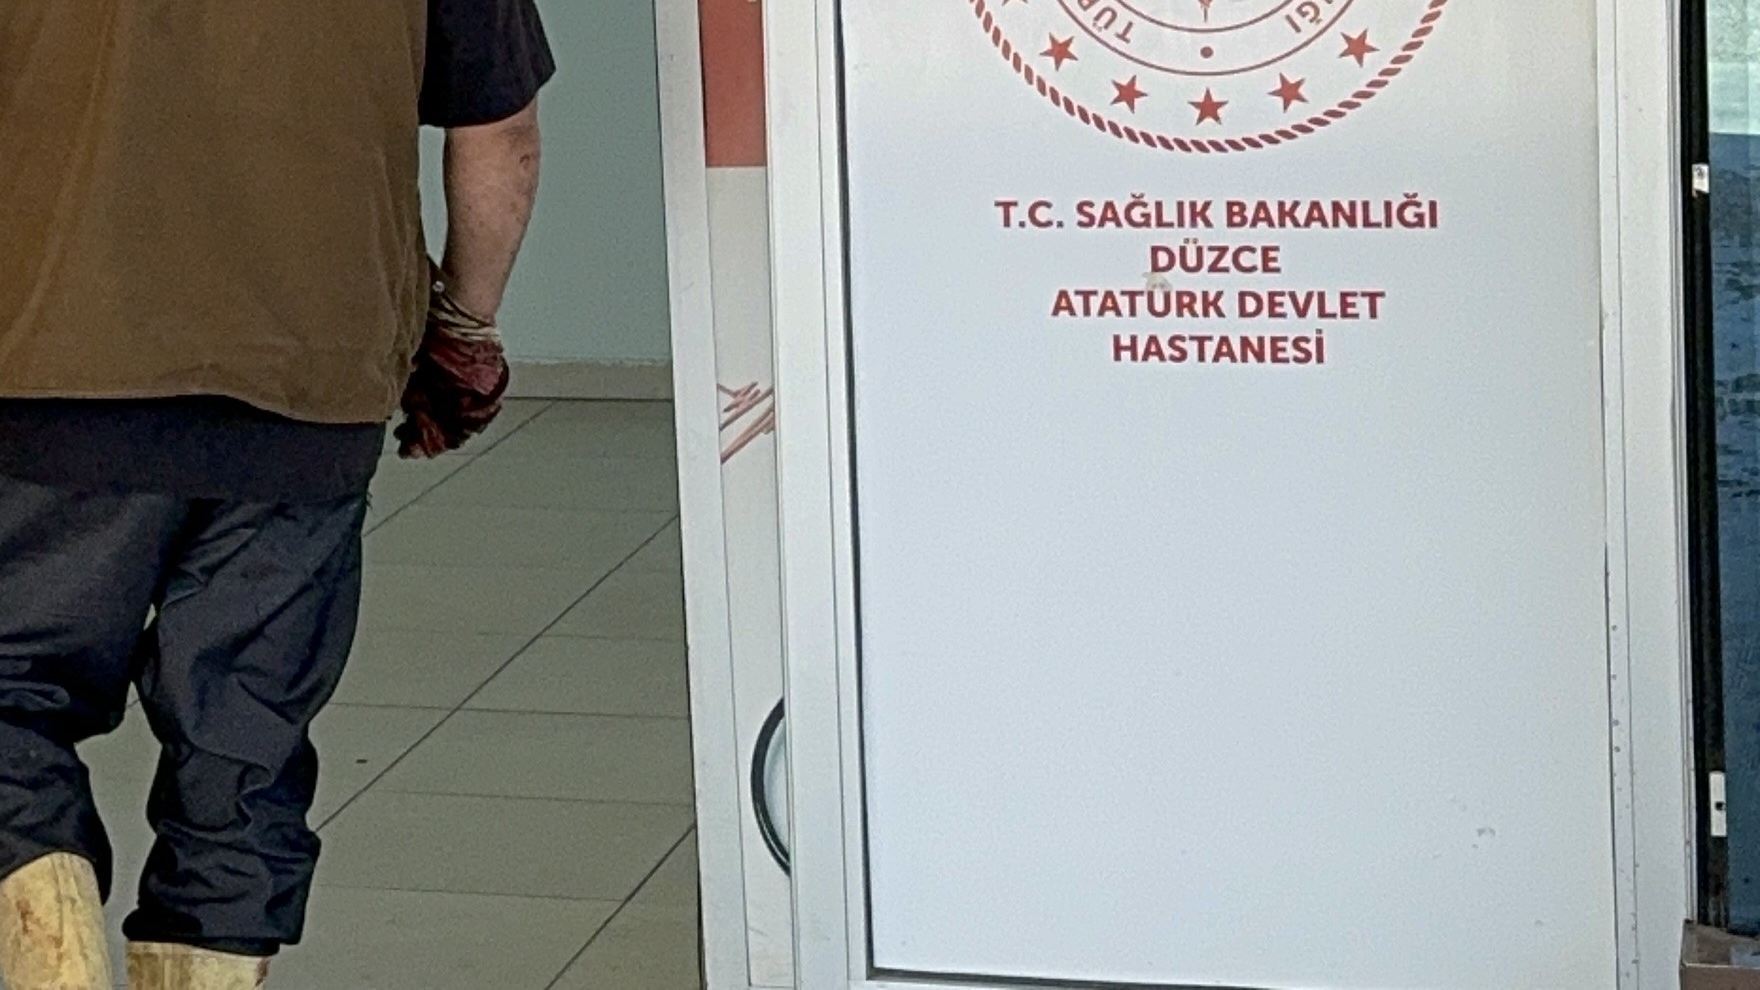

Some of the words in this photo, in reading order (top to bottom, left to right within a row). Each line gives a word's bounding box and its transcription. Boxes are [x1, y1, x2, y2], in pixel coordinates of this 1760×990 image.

[994, 200, 1064, 228] T.C.
[1076, 192, 1214, 228] SAĞLIK
[1225, 192, 1439, 229] BAKANLIĞI
[1150, 238, 1282, 274] DÜZCE
[1051, 282, 1227, 319] ATATÜRK
[1237, 290, 1387, 319] DEVLET
[1112, 328, 1326, 365] HASTANESİ
